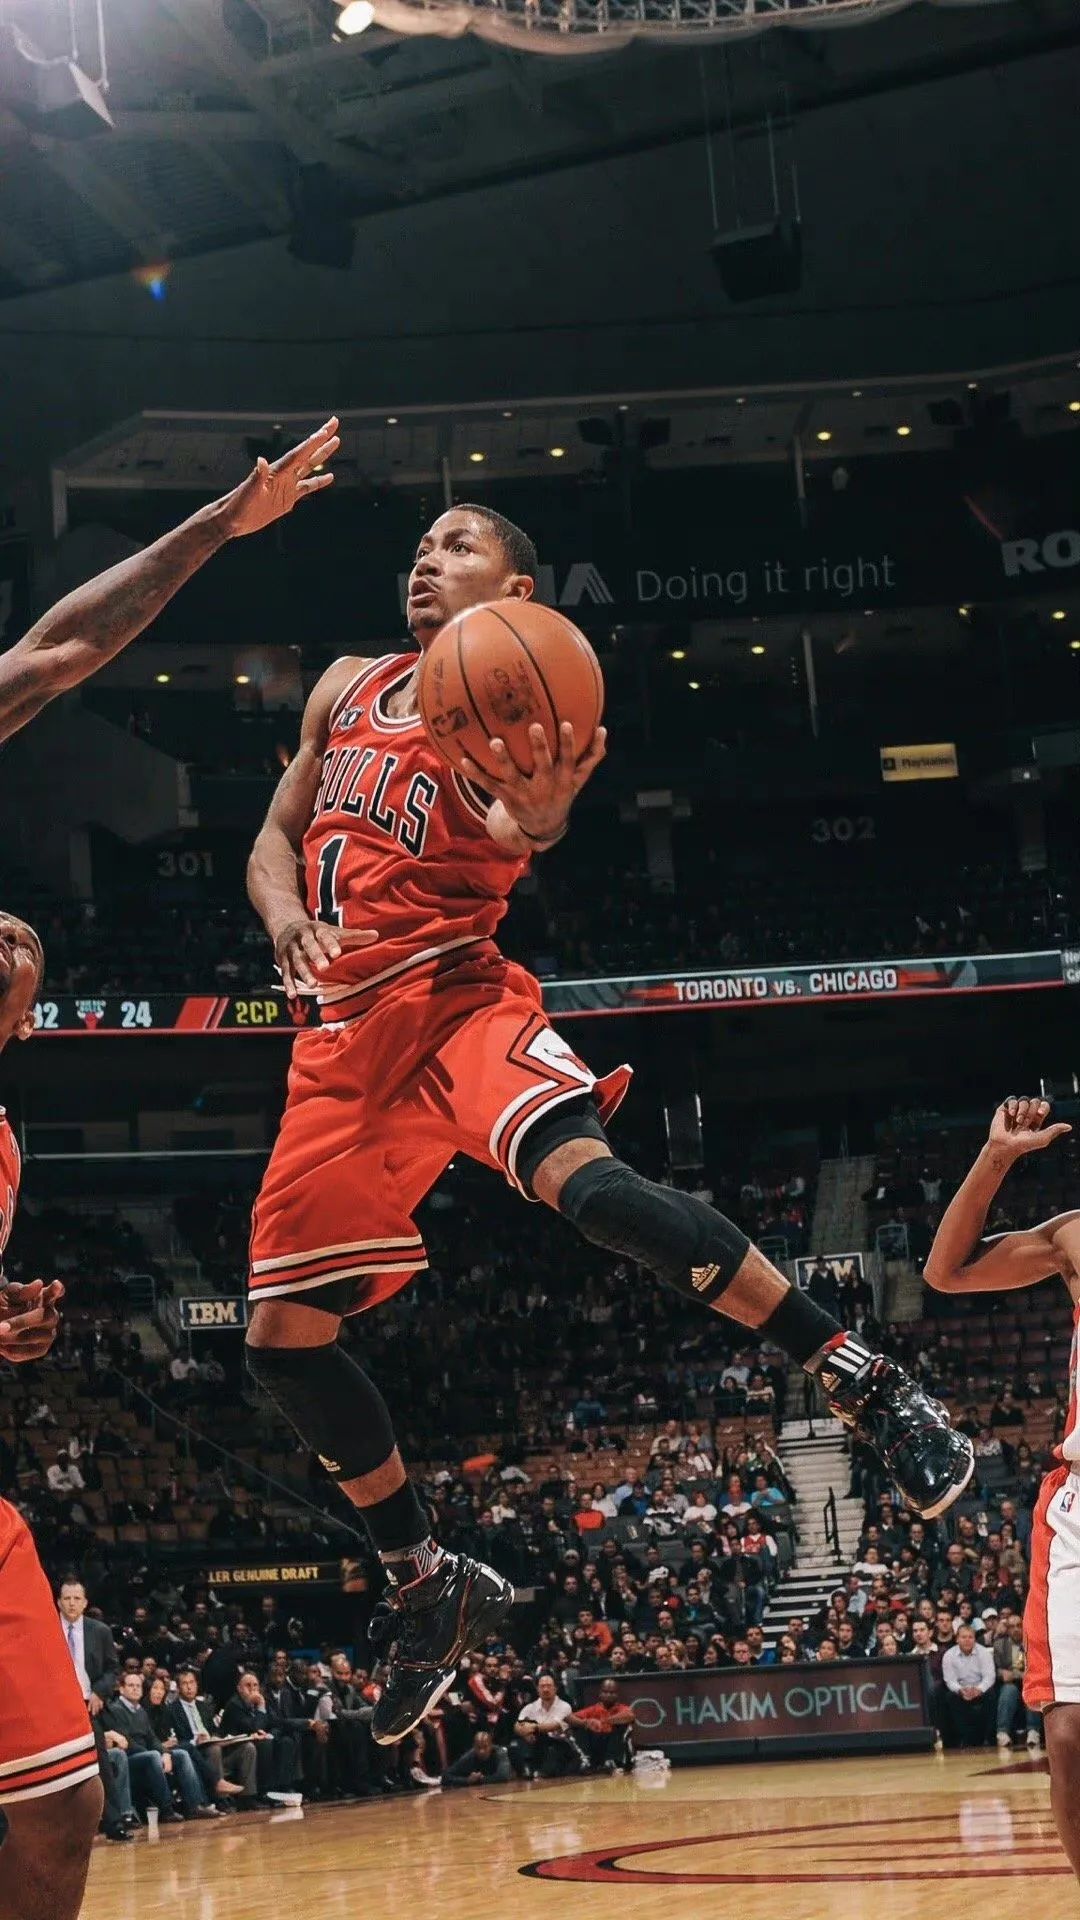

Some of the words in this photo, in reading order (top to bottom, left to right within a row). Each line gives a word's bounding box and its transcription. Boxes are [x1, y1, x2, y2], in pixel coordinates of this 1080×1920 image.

[636, 566, 748, 604] Doing
[764, 560, 789, 593] it
[804, 555, 897, 598] right
[811, 816, 877, 842] 302
[158, 851, 214, 877] 301
[314, 834, 348, 928] 1
[674, 976, 768, 1002] TORONTO
[773, 979, 802, 996] vs.
[809, 968, 898, 994] CHICAGO
[121, 1001, 152, 1028] 24
[235, 1000, 279, 1024] 2CP
[188, 1301, 238, 1325] IBM
[233, 1567, 280, 1582] GENUINE
[281, 1566, 319, 1580] DRAFT
[675, 1690, 779, 1726] HAKIM
[784, 1679, 920, 1717] OPTICAL
